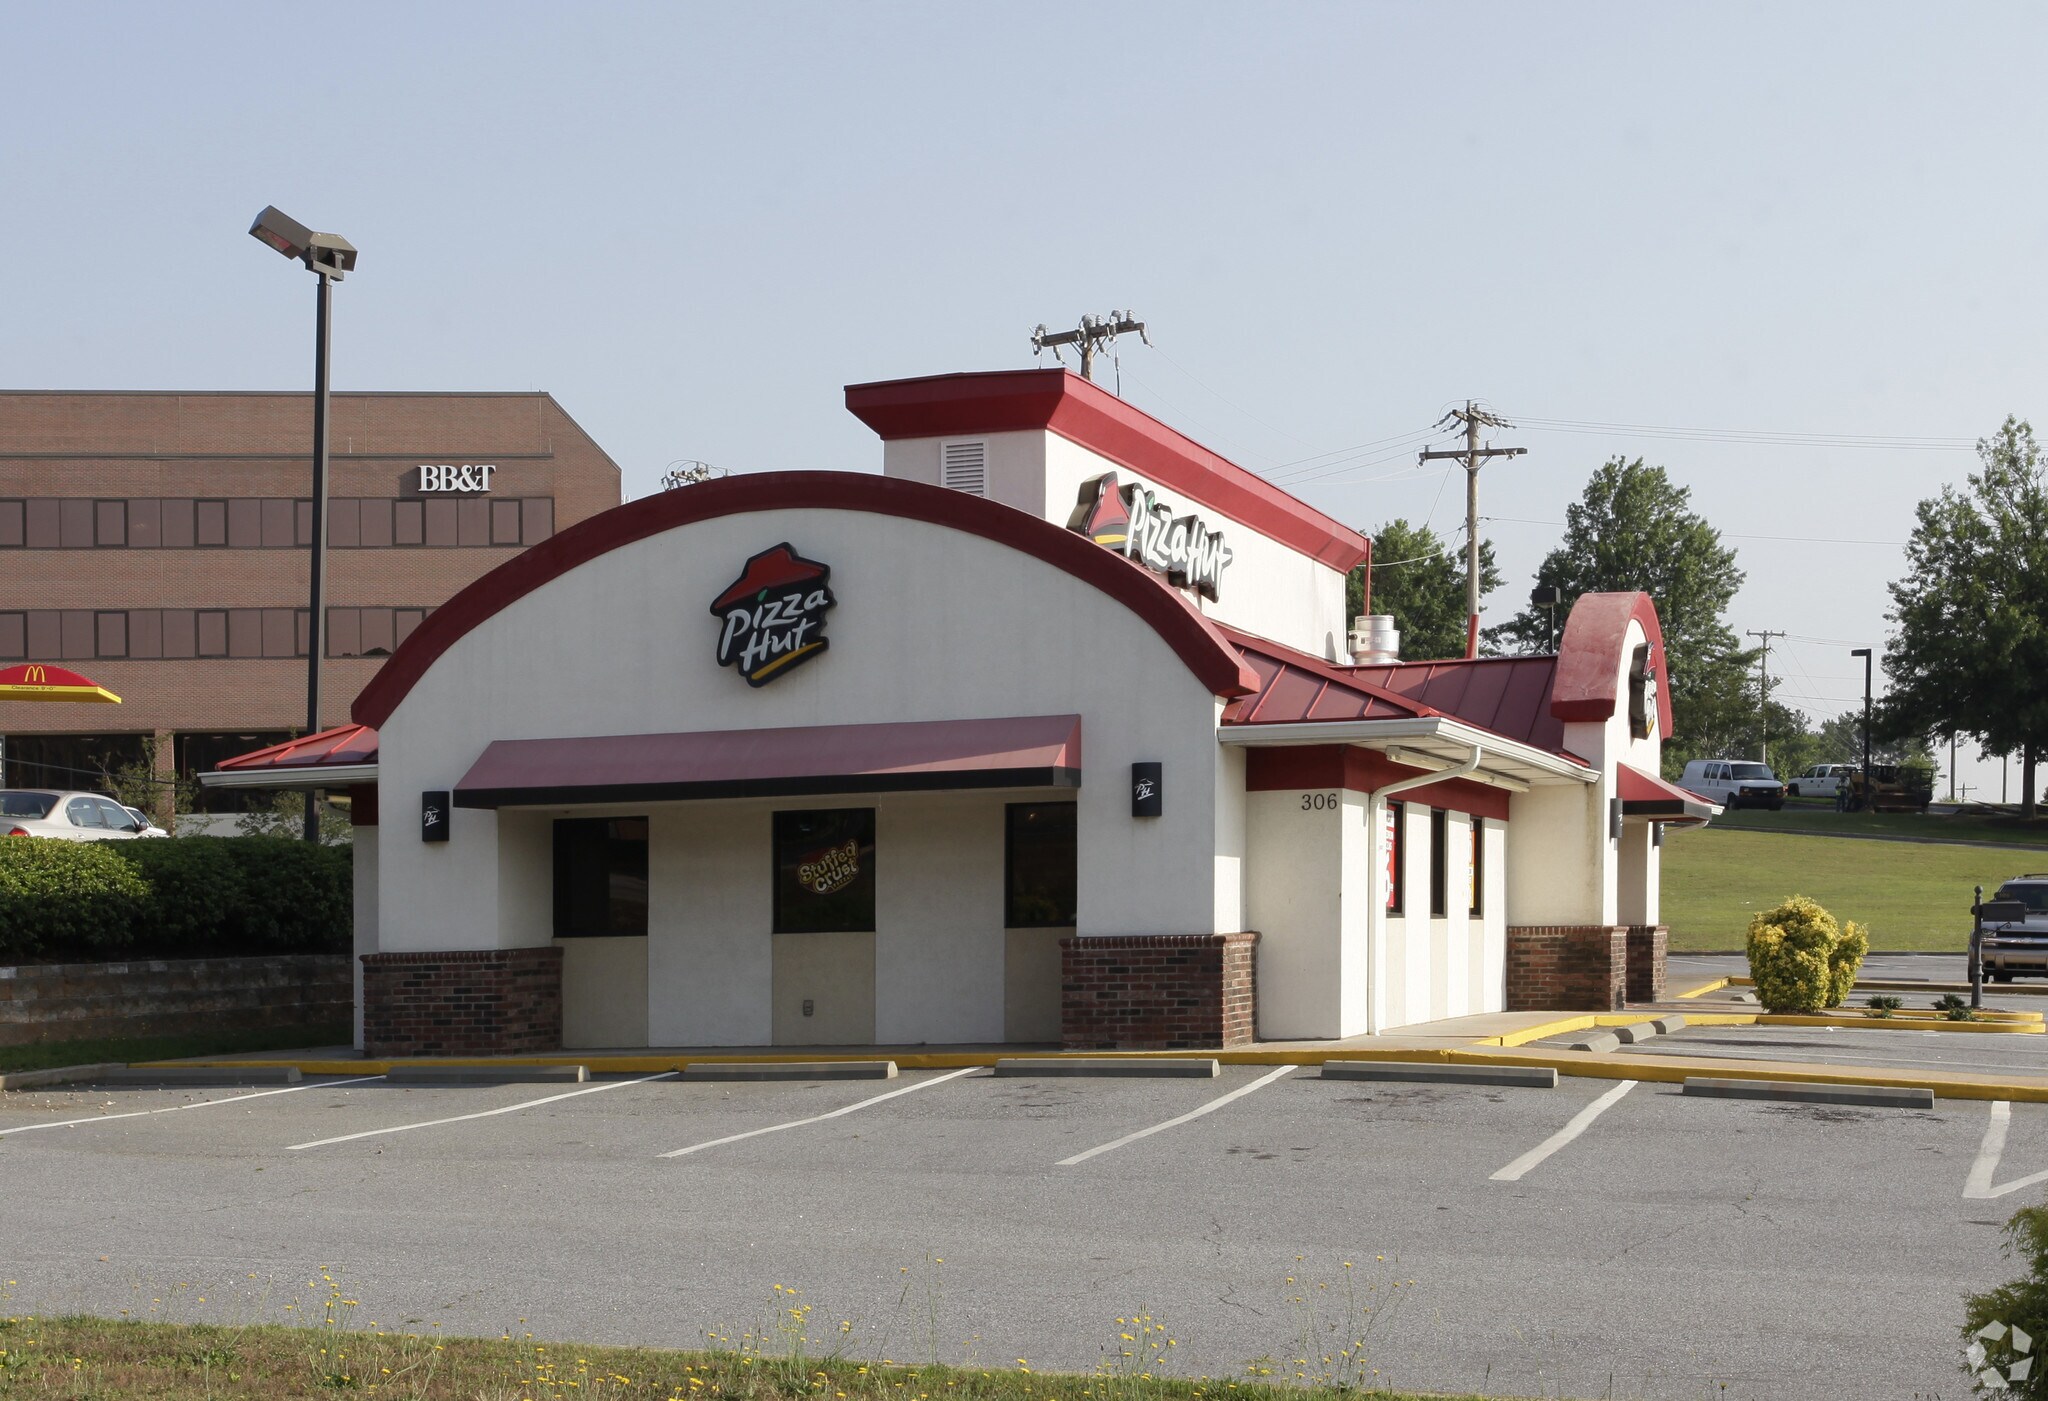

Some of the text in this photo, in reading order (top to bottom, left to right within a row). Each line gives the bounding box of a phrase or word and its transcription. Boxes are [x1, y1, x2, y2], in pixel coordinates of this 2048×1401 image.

[417, 464, 497, 492] BB&T
[1125, 488, 1232, 601] Pizza Hut
[720, 589, 829, 661] Pizza
[739, 617, 818, 672] Hut
[1301, 793, 1337, 810] 306
[799, 841, 856, 882] Stuffed
[815, 858, 858, 892] Crust
